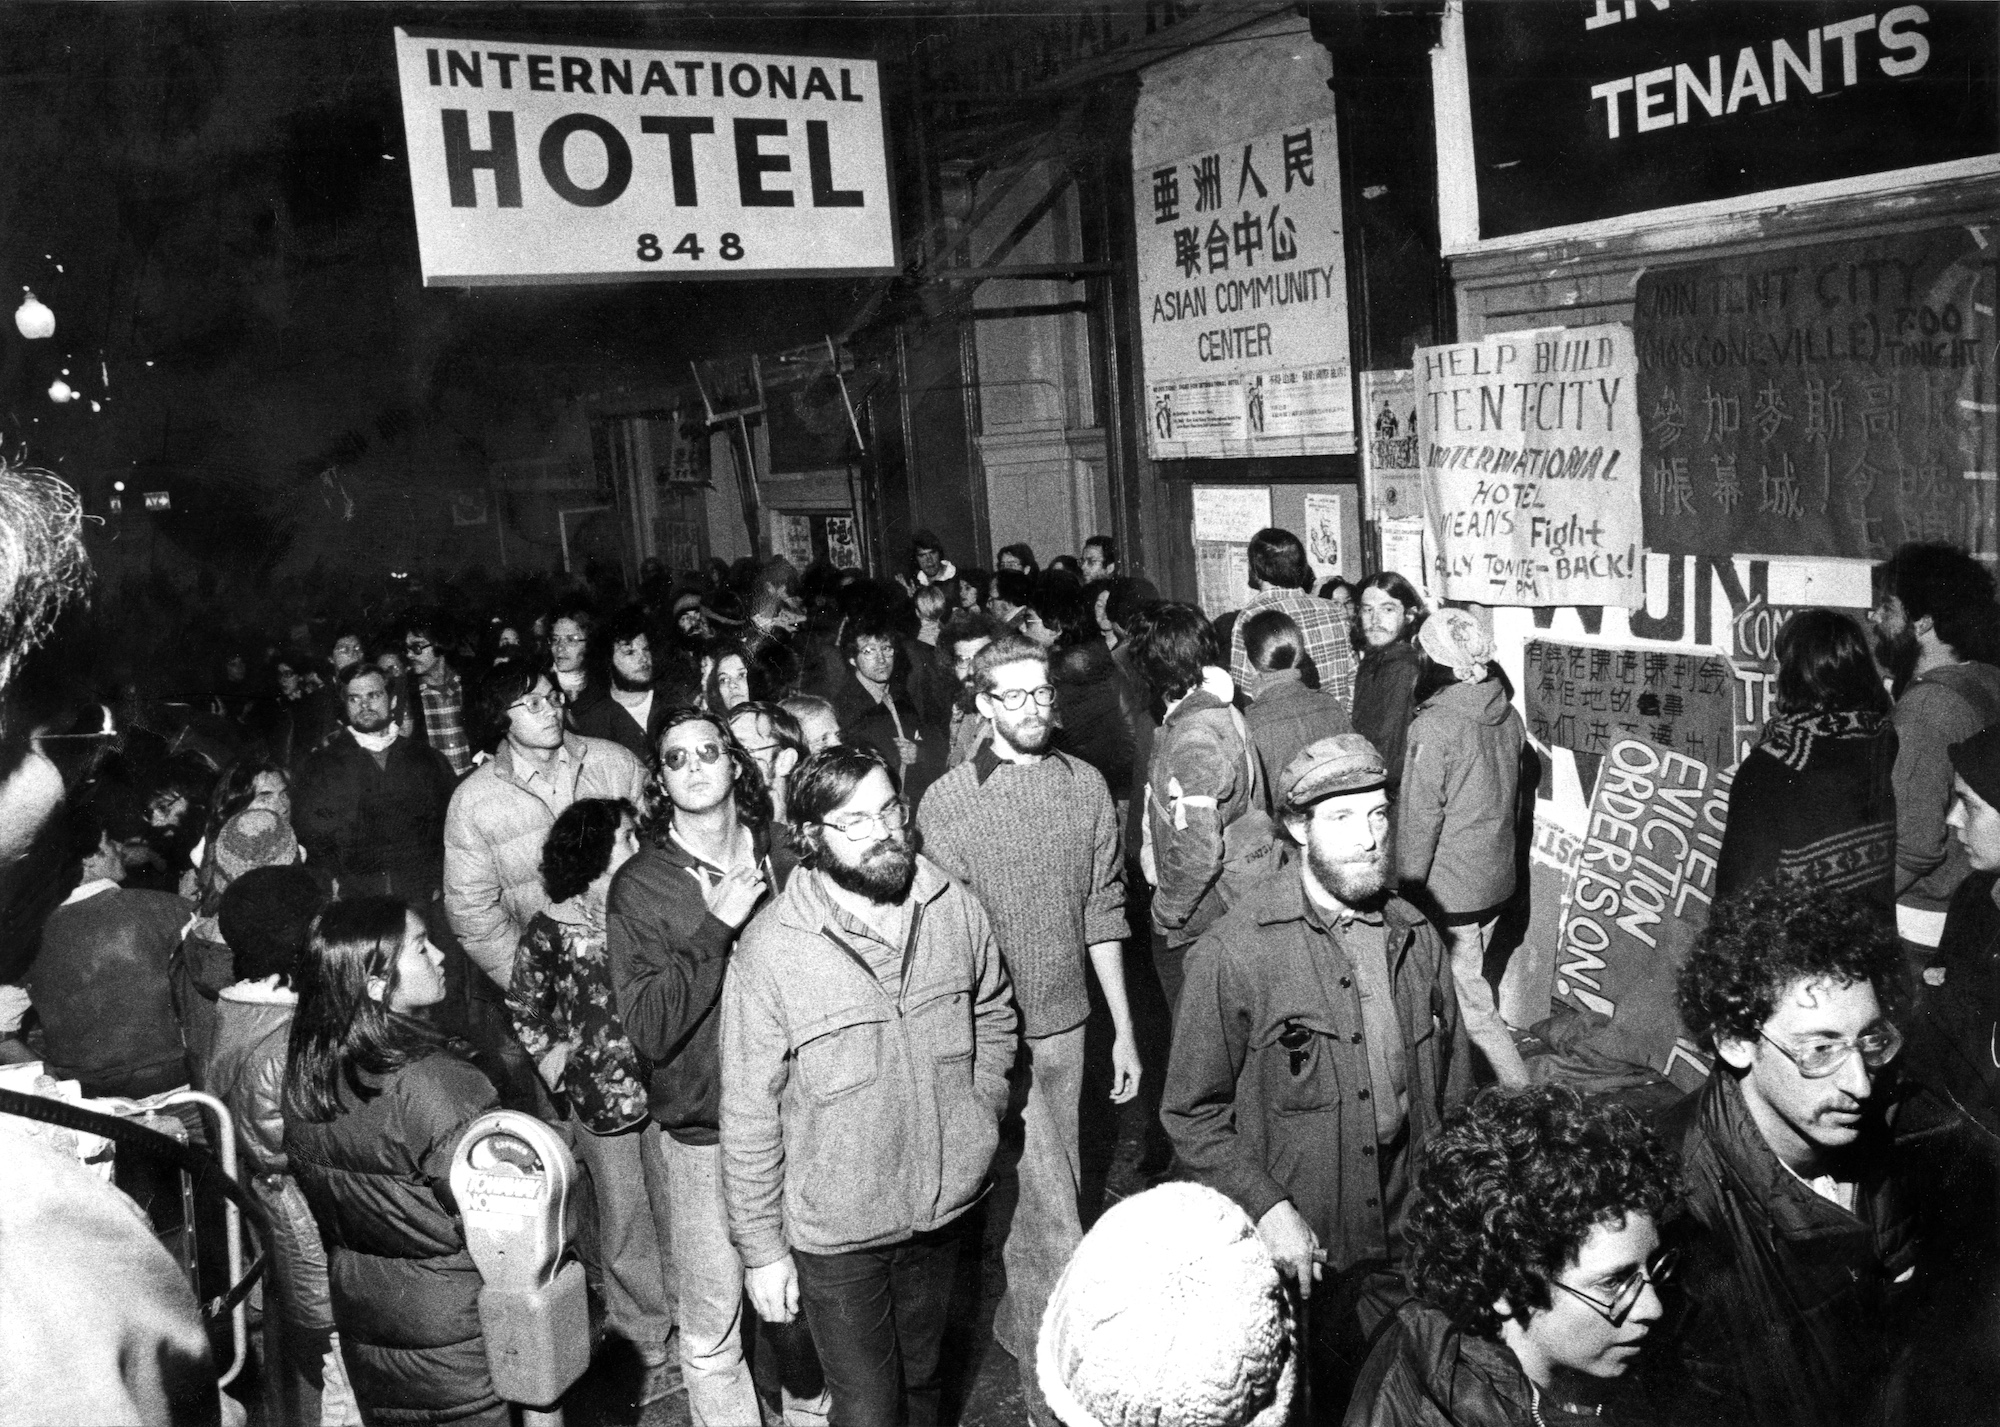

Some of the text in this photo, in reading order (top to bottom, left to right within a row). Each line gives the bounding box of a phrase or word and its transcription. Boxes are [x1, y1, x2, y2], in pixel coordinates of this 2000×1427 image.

[426, 48, 863, 102] INTERNATIONAL
[1591, 5, 1930, 139] TENANTS
[441, 108, 865, 208] HOTEL
[636, 232, 744, 262] 848
[1152, 265, 1333, 323] ASIAN COMMUNITY
[1708, 266, 1798, 315] TENT
[1816, 254, 1926, 308] CITY
[1199, 322, 1272, 362] CENTER
[1425, 337, 1614, 381] HELP BUILD
[1427, 443, 1621, 481] INTERNATIONAL
[1472, 480, 1546, 508] HOTEL
[1531, 513, 1605, 557] Fight
[1556, 543, 1635, 580] BACK!
[1489, 579, 1539, 598] 7 PM
[1615, 750, 1708, 949] EVICTION
[1557, 738, 1661, 1018] ORDER IS ON!
